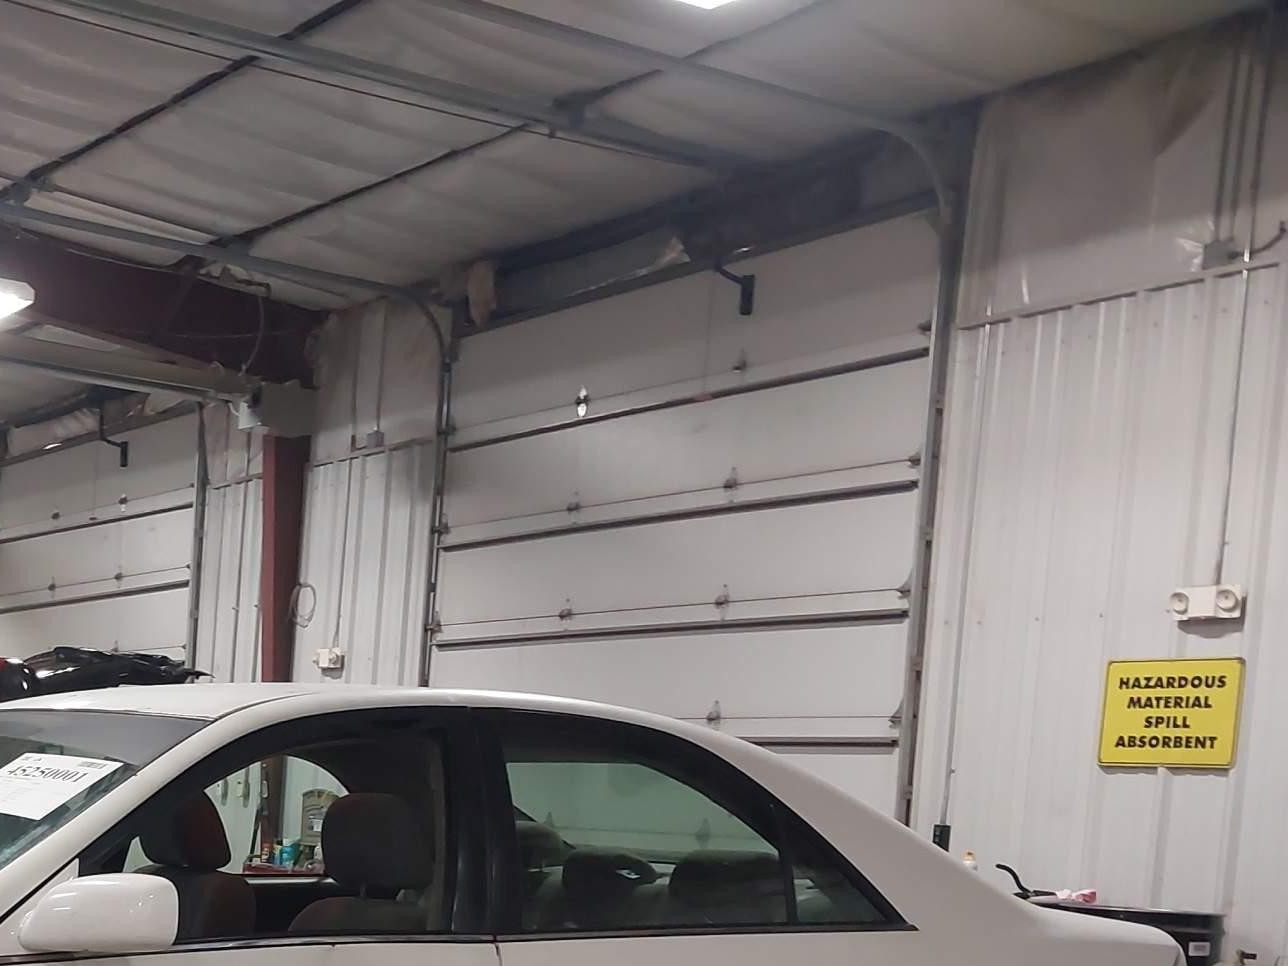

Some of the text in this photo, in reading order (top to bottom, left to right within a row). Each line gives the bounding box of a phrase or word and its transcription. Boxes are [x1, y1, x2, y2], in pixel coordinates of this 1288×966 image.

[1118, 675, 1227, 690] HAZARDOUS
[1127, 696, 1212, 709] MATERIAL
[1144, 716, 1190, 728] SPILL
[1115, 736, 1217, 748] ABSORBENT
[7, 765, 89, 782] 45250001
